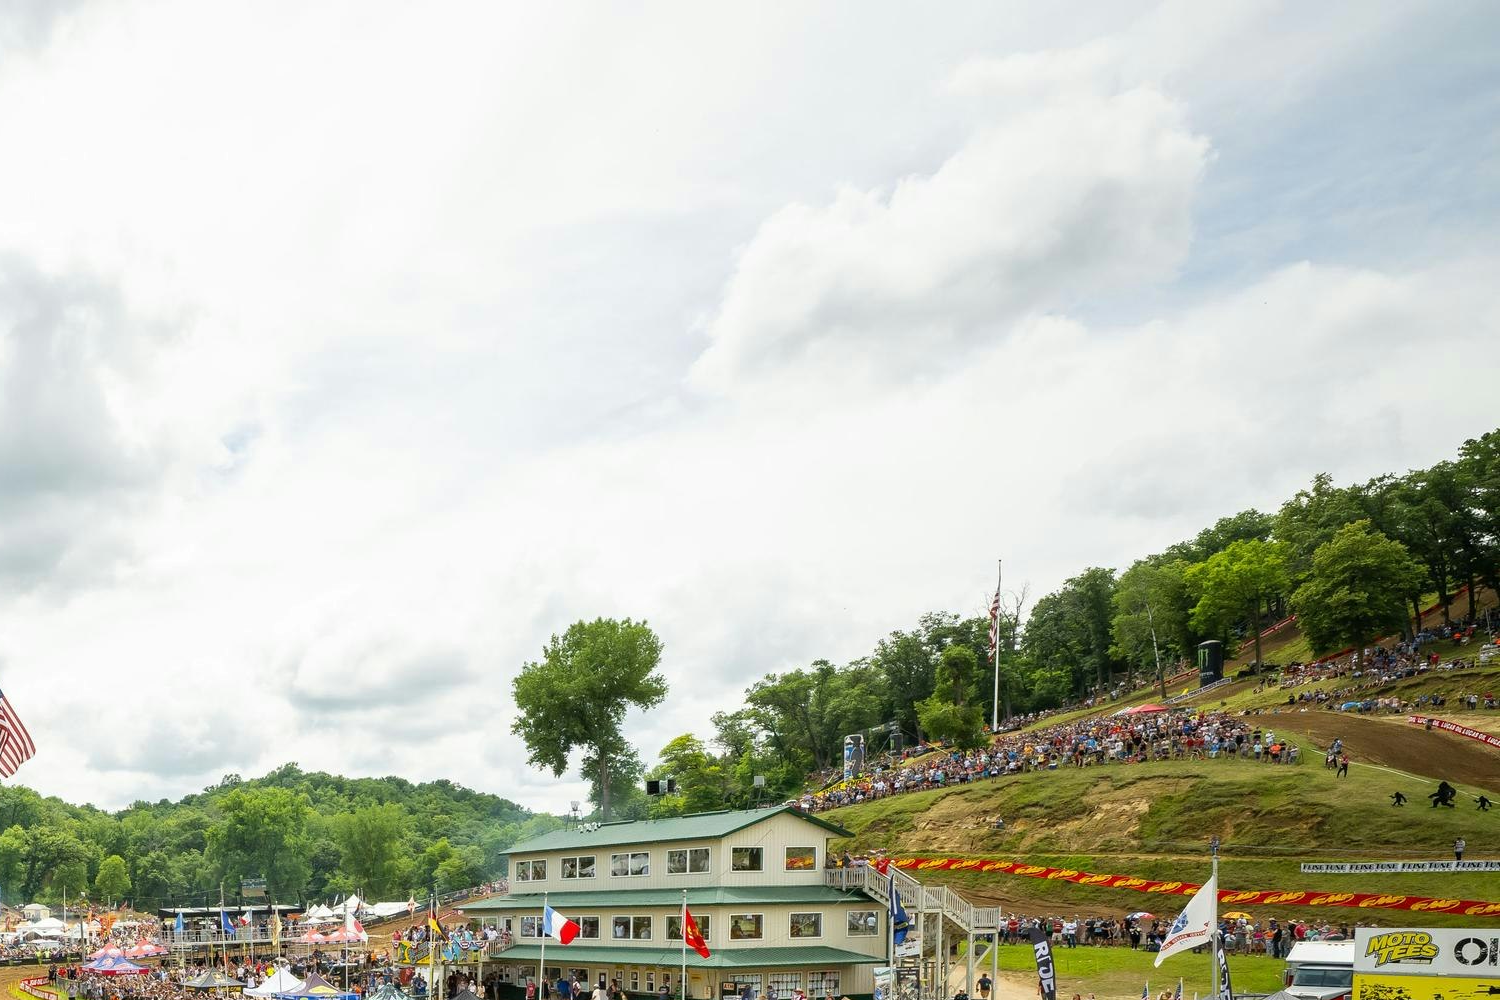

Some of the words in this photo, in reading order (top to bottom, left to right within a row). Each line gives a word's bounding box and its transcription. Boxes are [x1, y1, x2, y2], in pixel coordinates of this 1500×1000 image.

[1441, 721, 1455, 731] LUCAS
[1462, 728, 1478, 738] LUCAS
[1366, 931, 1432, 956] MOTO
[1374, 943, 1440, 967] TEES
